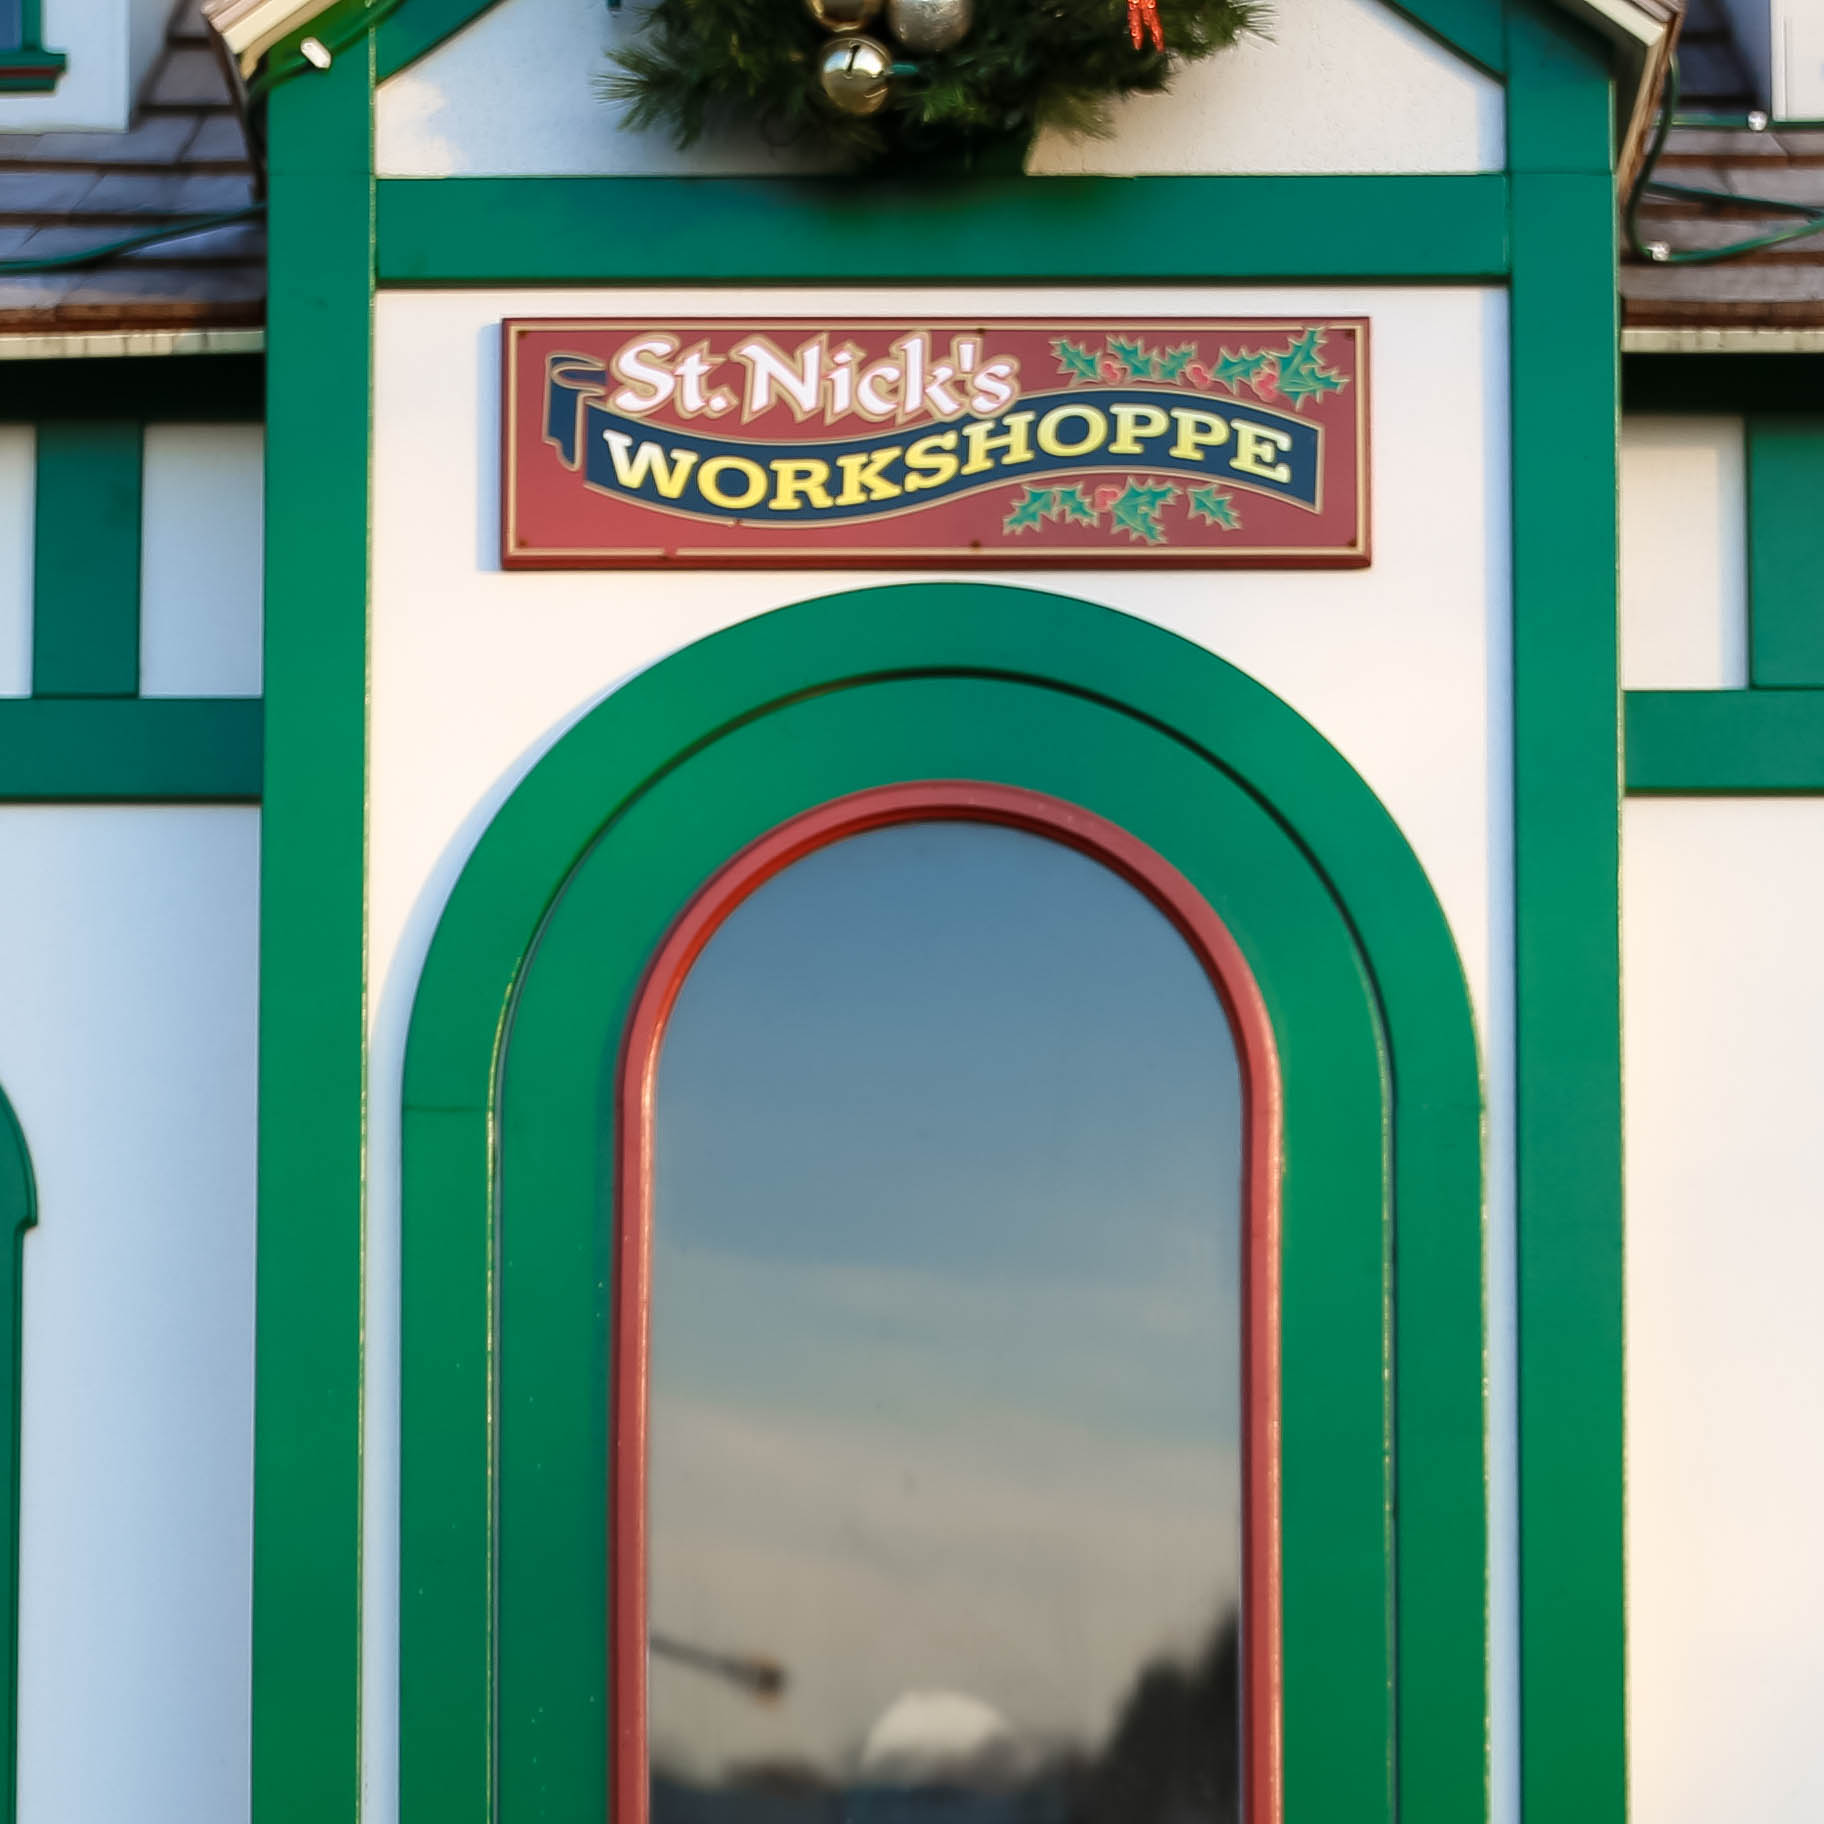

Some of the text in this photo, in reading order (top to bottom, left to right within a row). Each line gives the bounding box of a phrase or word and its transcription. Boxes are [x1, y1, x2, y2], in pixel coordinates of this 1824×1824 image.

[612, 335, 1015, 416] St. Nick's
[603, 405, 1291, 511] WORKSHOPPE
